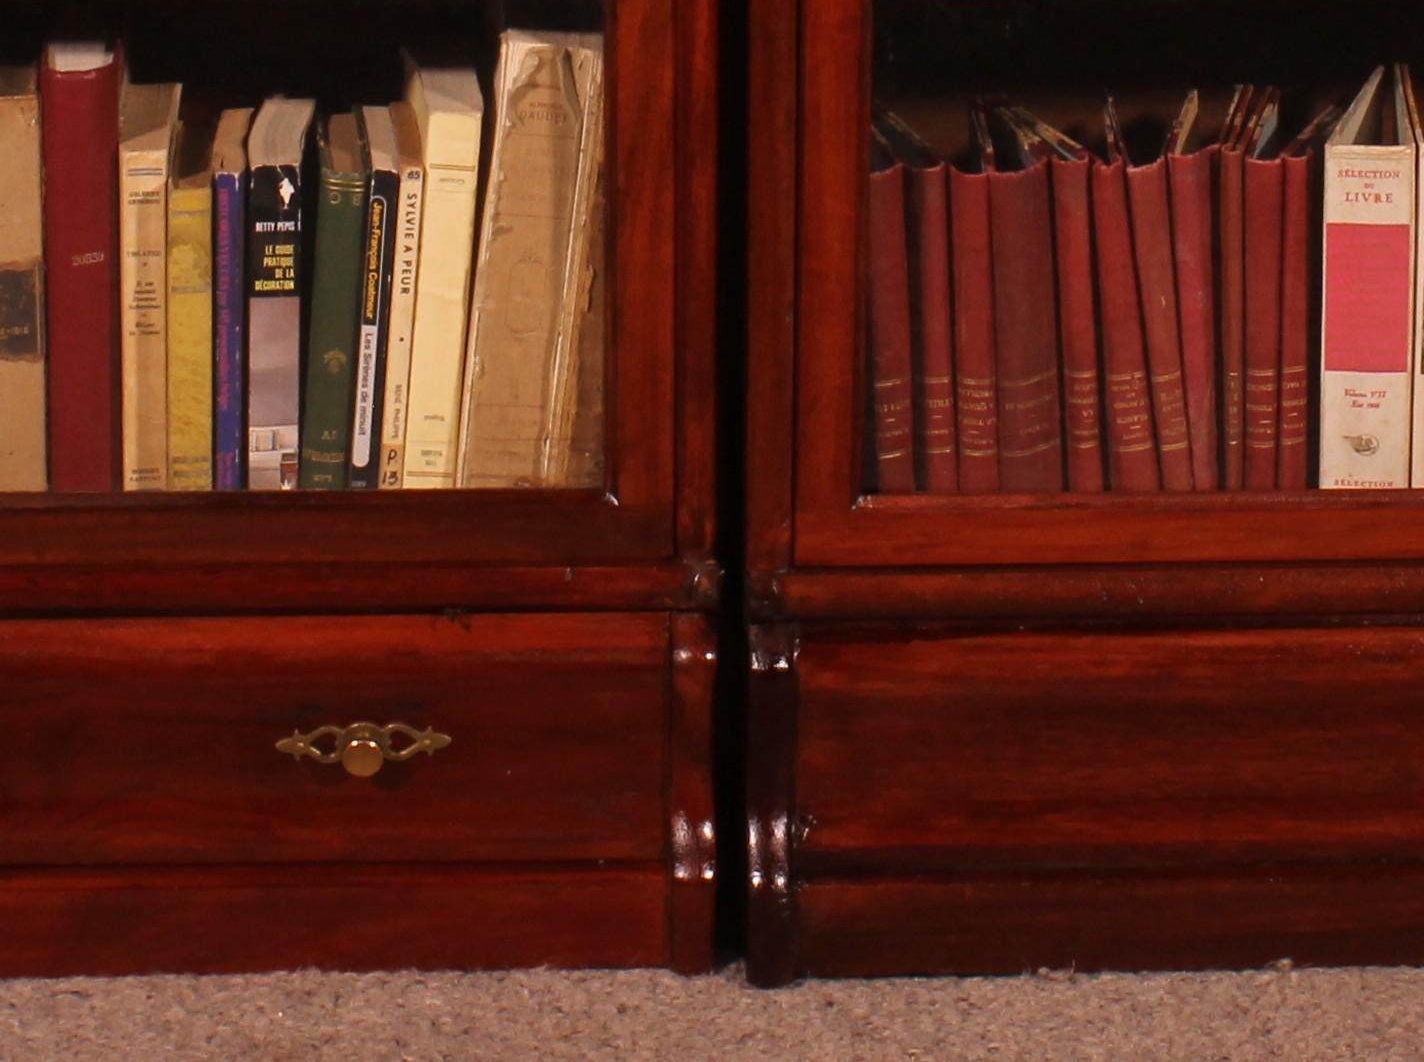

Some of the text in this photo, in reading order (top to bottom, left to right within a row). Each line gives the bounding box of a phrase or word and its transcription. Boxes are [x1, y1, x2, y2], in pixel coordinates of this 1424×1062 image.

[1337, 168, 1401, 180] SÉLECTION
[1344, 191, 1394, 204] LIVRE
[255, 220, 296, 232] BETTY PEPIS
[369, 201, 383, 270] Jean-François
[265, 244, 273, 255] LE
[400, 193, 419, 296] SYLVIE A PEUR
[263, 256, 294, 267] PRATIQUE
[275, 268, 295, 279] DE LA
[254, 279, 295, 291] DÉCORATION
[364, 332, 374, 352] Les
[359, 390, 371, 405] de
[357, 405, 369, 436] minuit
